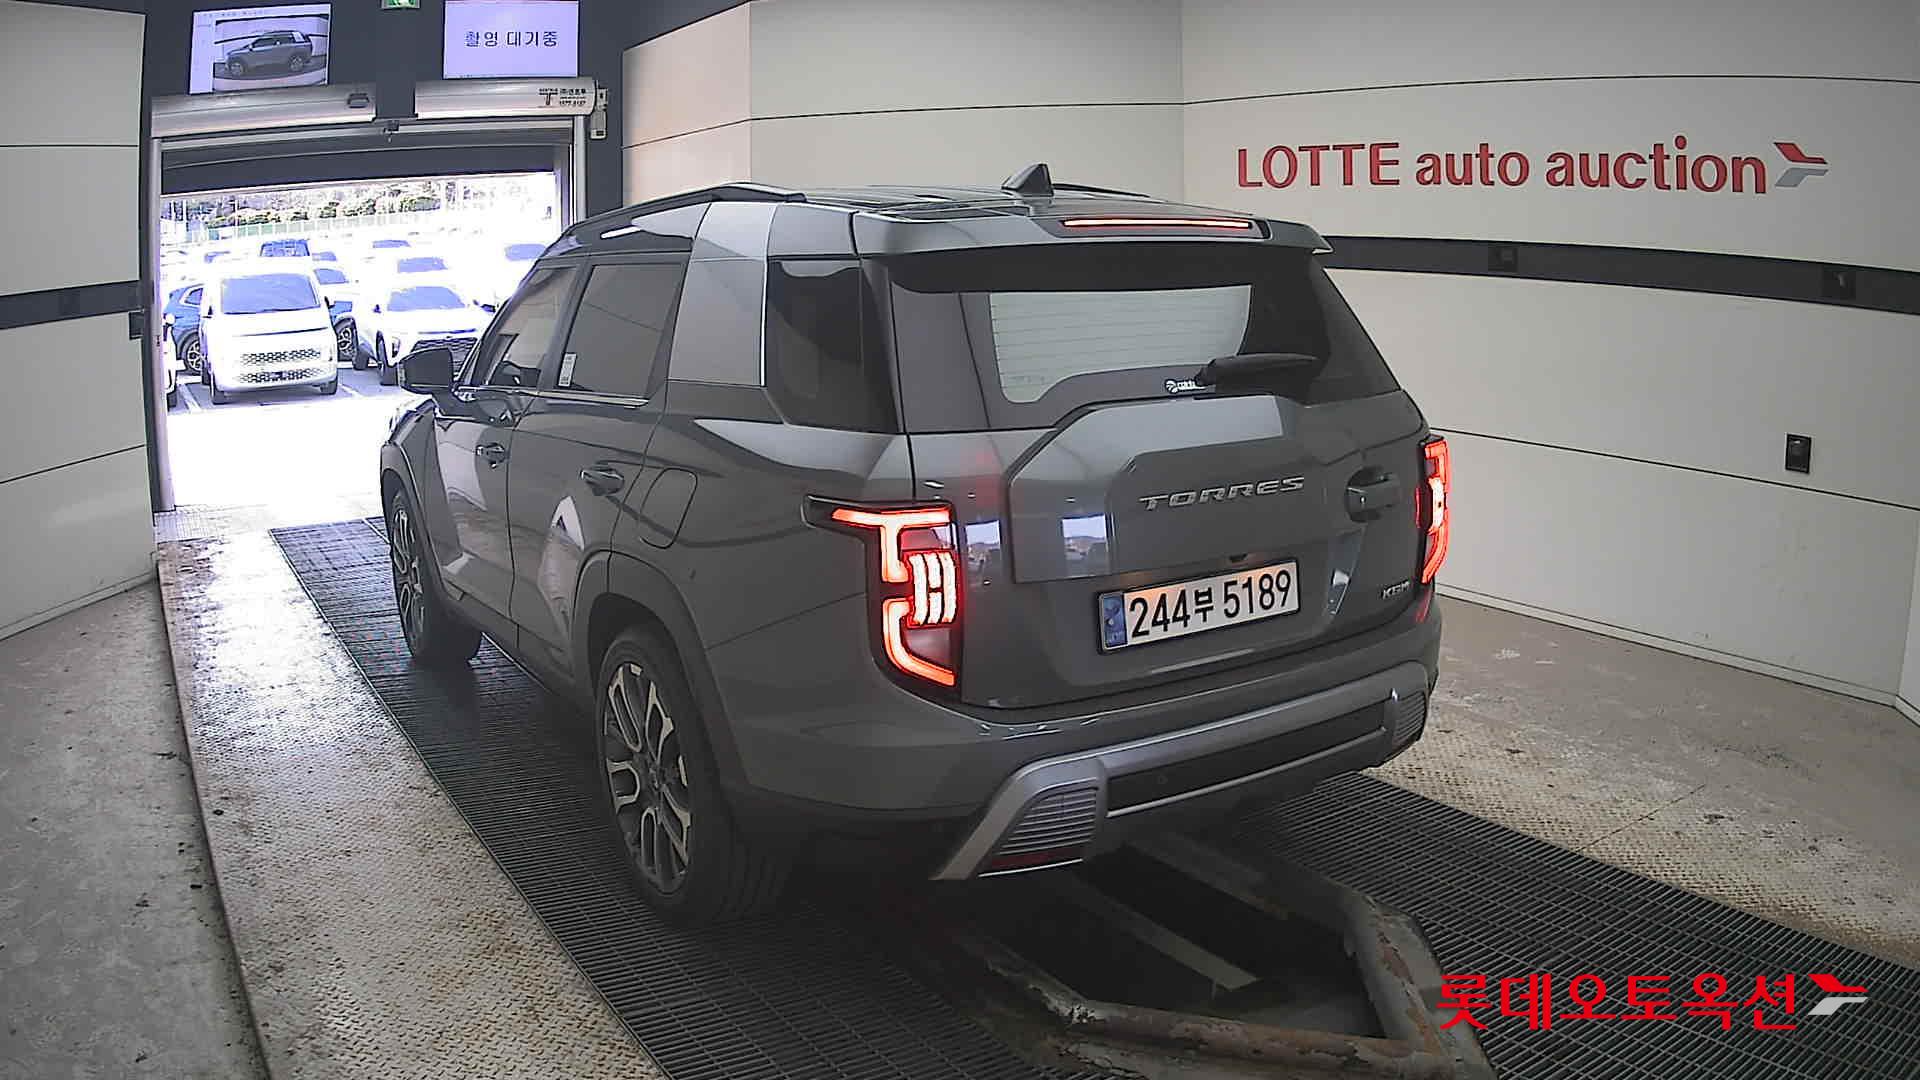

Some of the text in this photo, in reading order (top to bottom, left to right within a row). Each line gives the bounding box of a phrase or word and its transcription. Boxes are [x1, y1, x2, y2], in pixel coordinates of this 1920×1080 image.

[506, 31, 557, 47] 대기중
[1237, 136, 1767, 194] LOTTE auto auction
[1139, 477, 1304, 511] TORRES
[1129, 569, 1291, 638] 244부 5189
[1382, 580, 1409, 600] KGM
